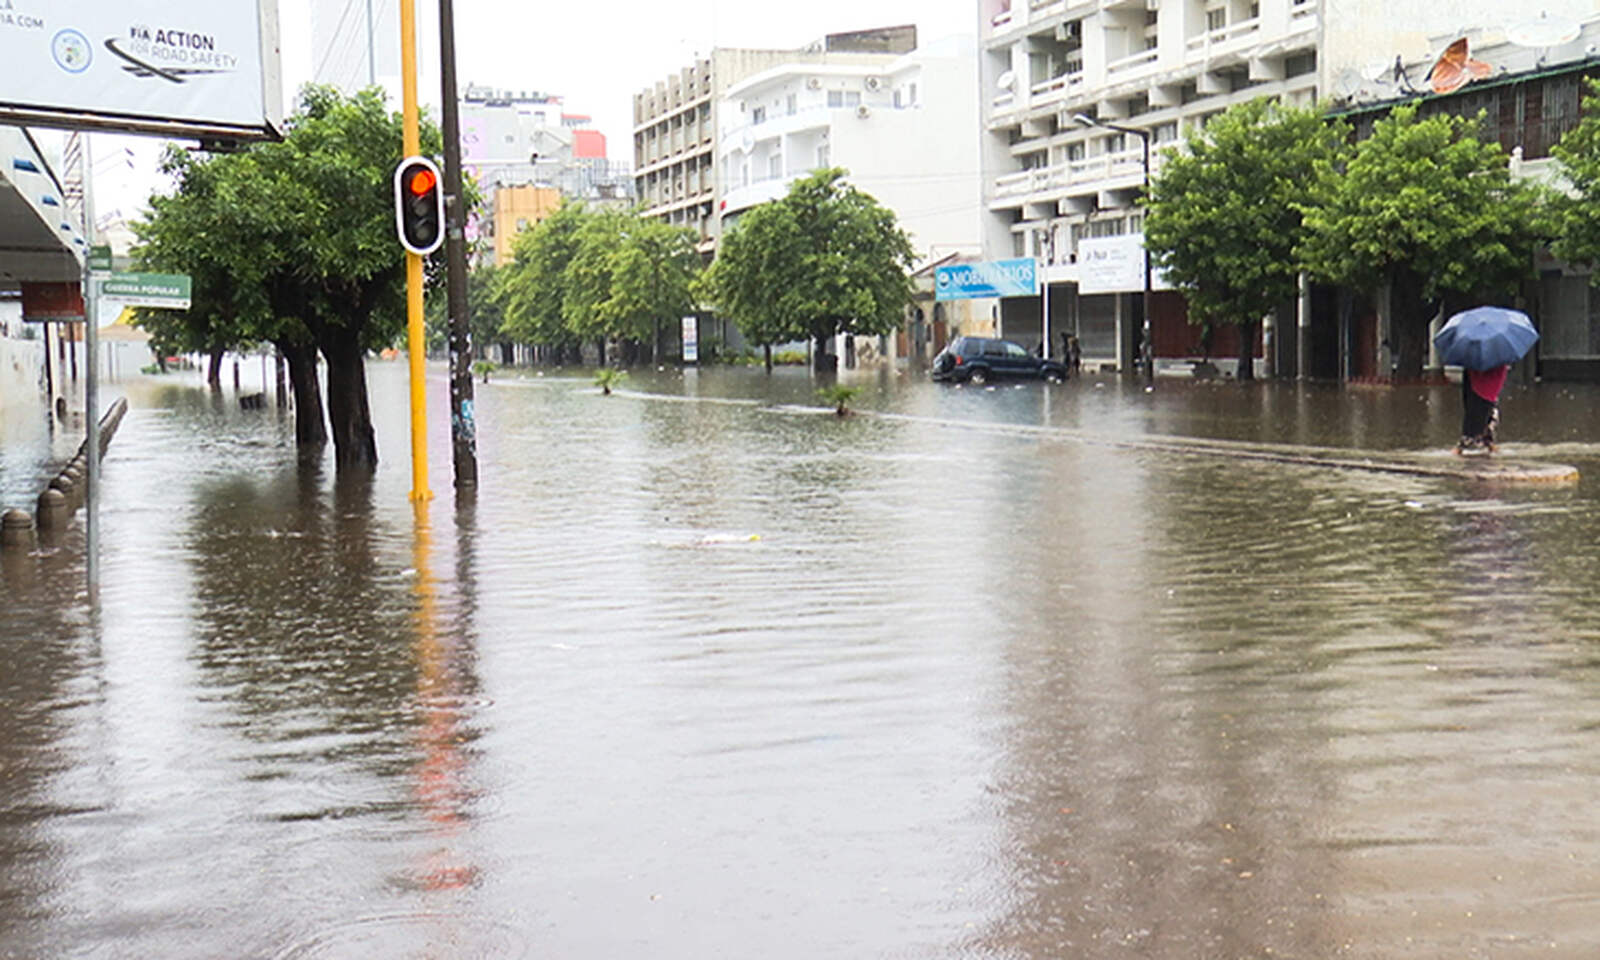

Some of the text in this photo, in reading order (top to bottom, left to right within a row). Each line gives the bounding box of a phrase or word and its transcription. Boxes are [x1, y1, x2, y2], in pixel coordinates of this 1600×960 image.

[155, 30, 214, 49] ACTION
[130, 43, 238, 66] FOR ROAD SAFETY
